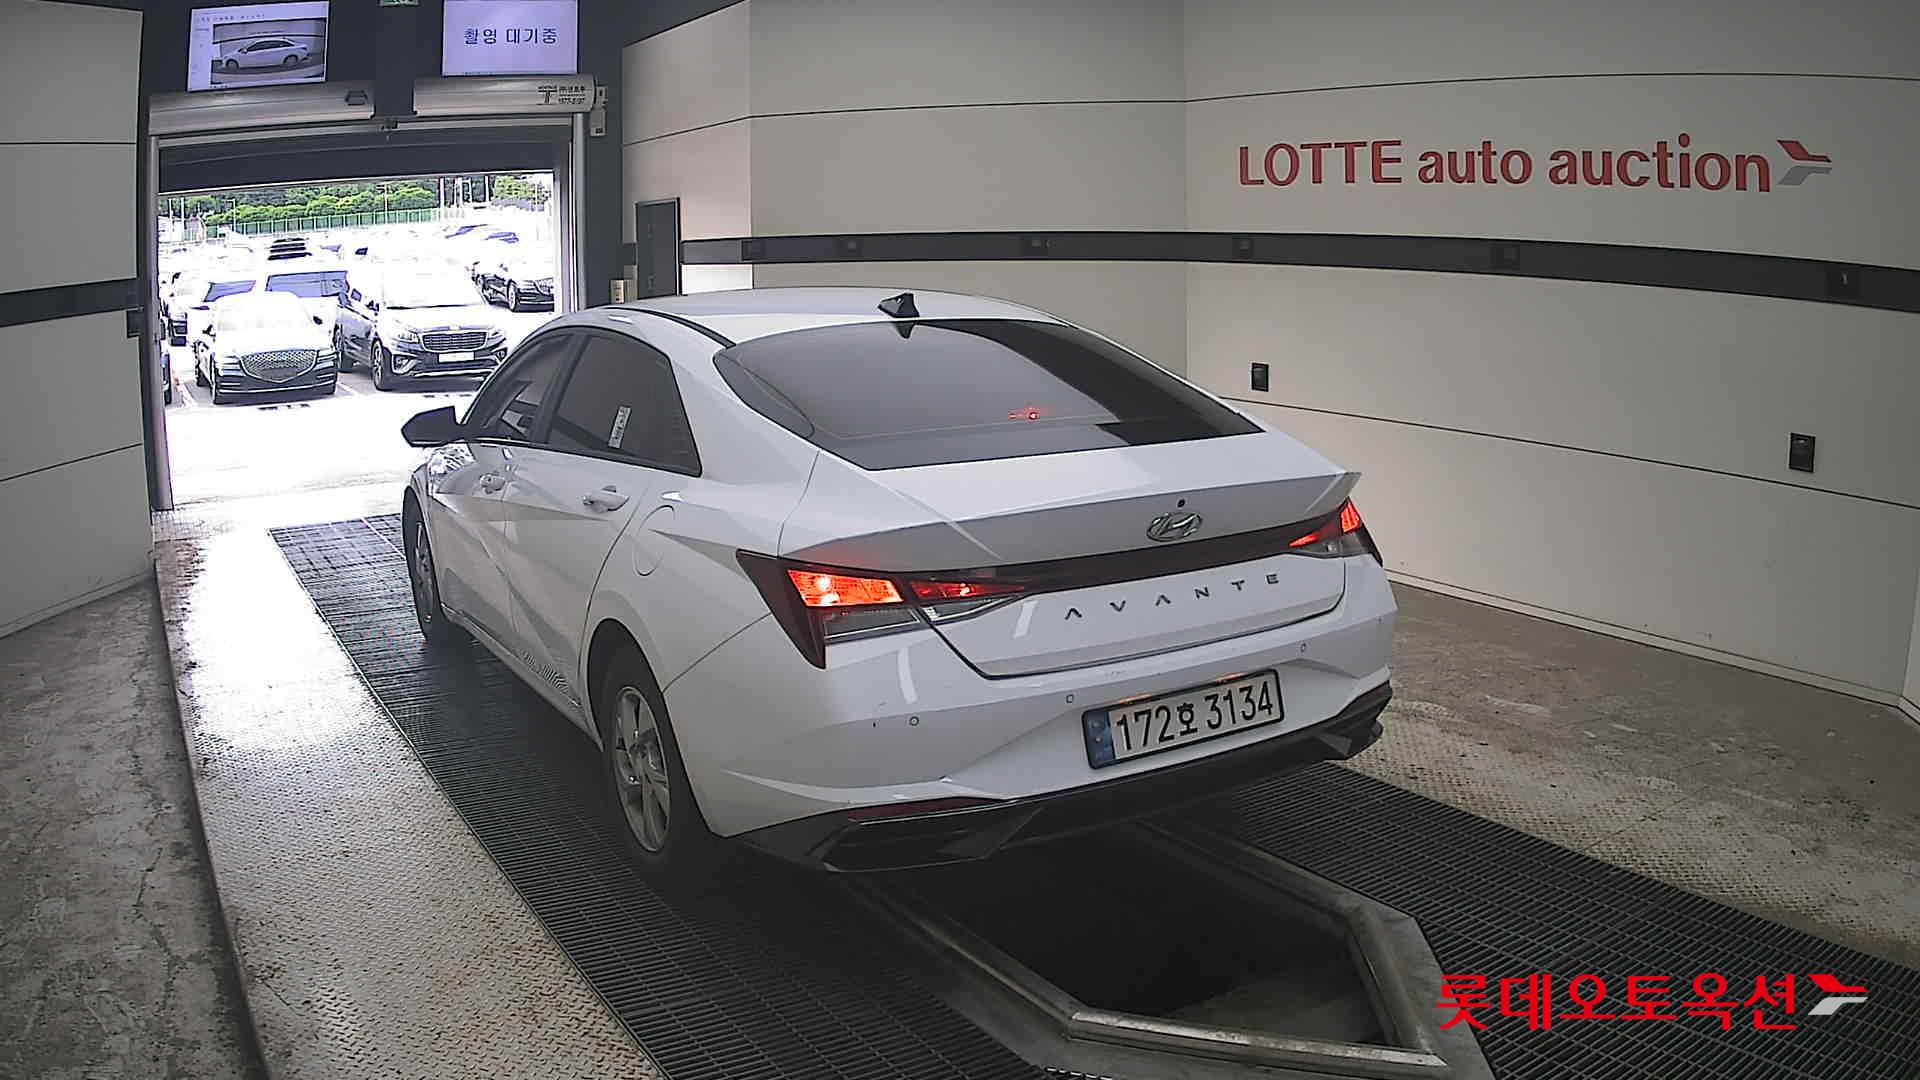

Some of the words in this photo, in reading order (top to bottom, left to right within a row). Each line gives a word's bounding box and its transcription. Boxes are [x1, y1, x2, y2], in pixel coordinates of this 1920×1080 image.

[464, 28, 497, 45] 촬영
[506, 27, 558, 45] 대기중
[1239, 141, 1401, 186] LOTTE
[1418, 140, 1533, 186] auto
[1550, 133, 1772, 193] auction
[1064, 573, 1280, 621] AVANTE
[1116, 702, 1198, 751] 172호
[1204, 680, 1274, 730] 3134
